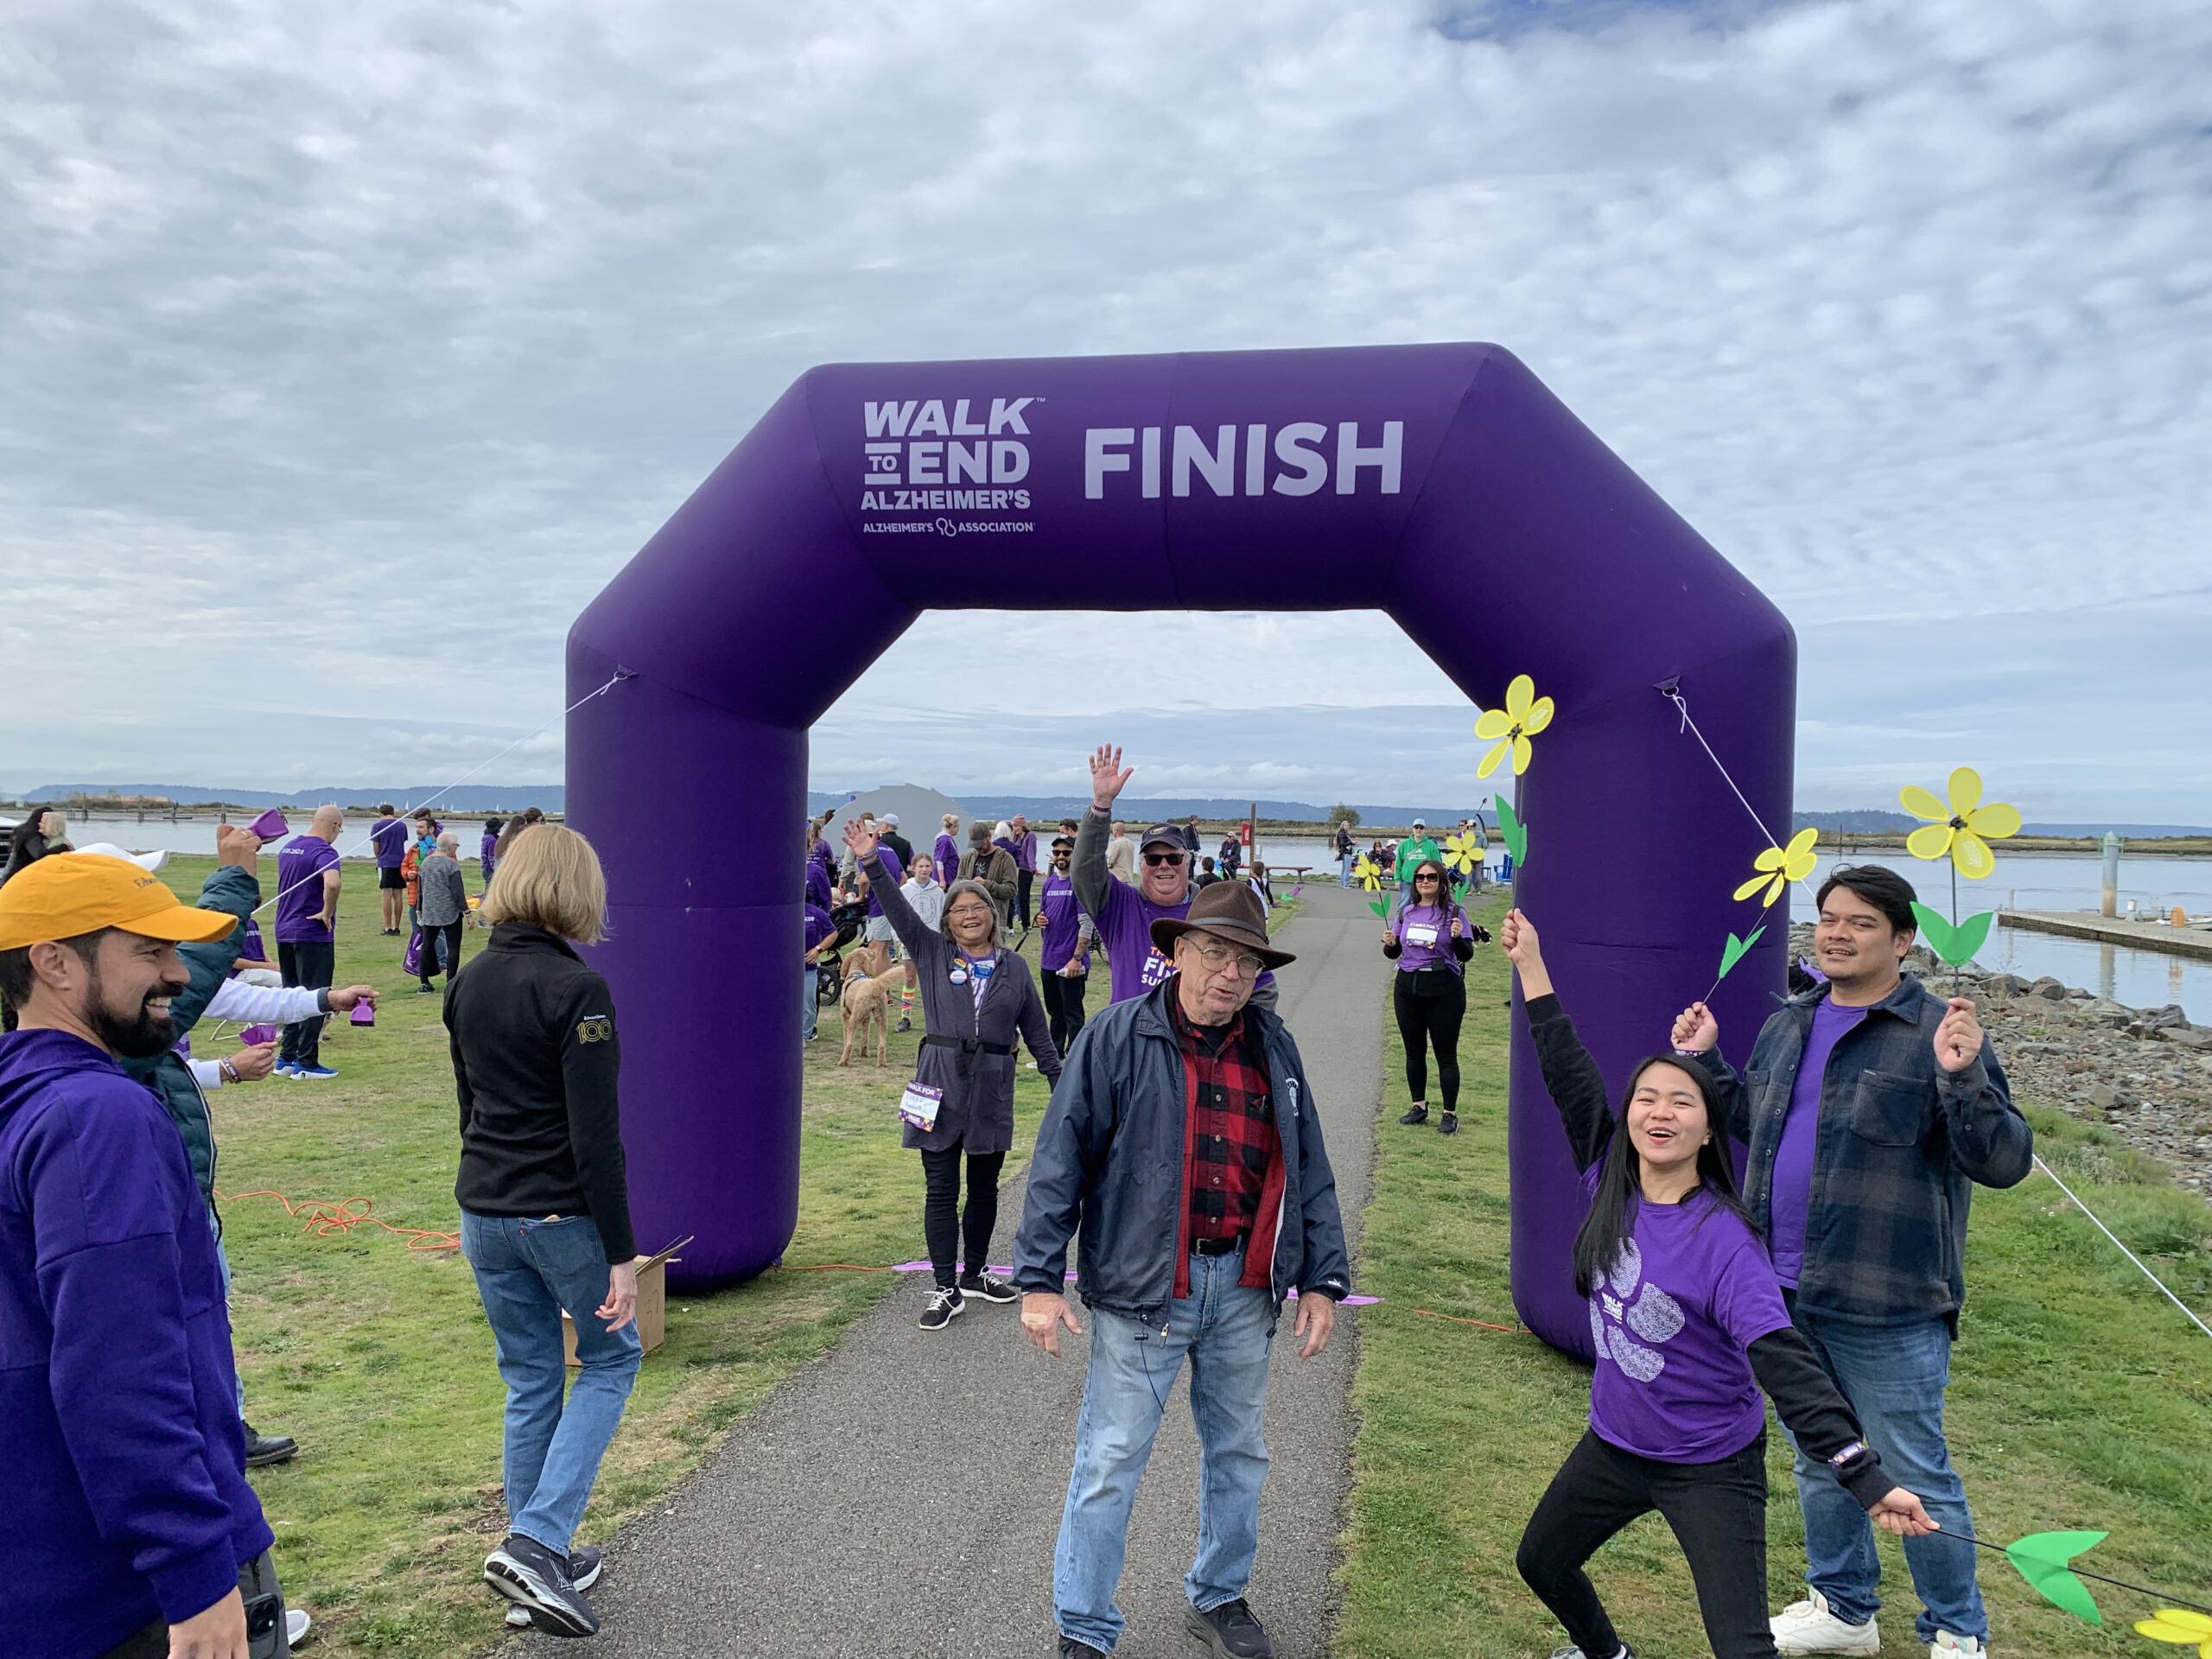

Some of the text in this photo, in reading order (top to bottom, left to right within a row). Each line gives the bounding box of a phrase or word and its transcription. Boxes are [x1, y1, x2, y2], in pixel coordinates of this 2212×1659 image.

[864, 397, 1034, 437] WALK
[868, 441, 1030, 484] TO END
[1085, 421, 1403, 499] FINISH
[861, 489, 1031, 511] ALZHEIMER'S
[863, 522, 1033, 533] ALZHEIMER'S ASSOCIATION
[575, 1020, 612, 1044] 100
[922, 1087, 936, 1096] FOR
